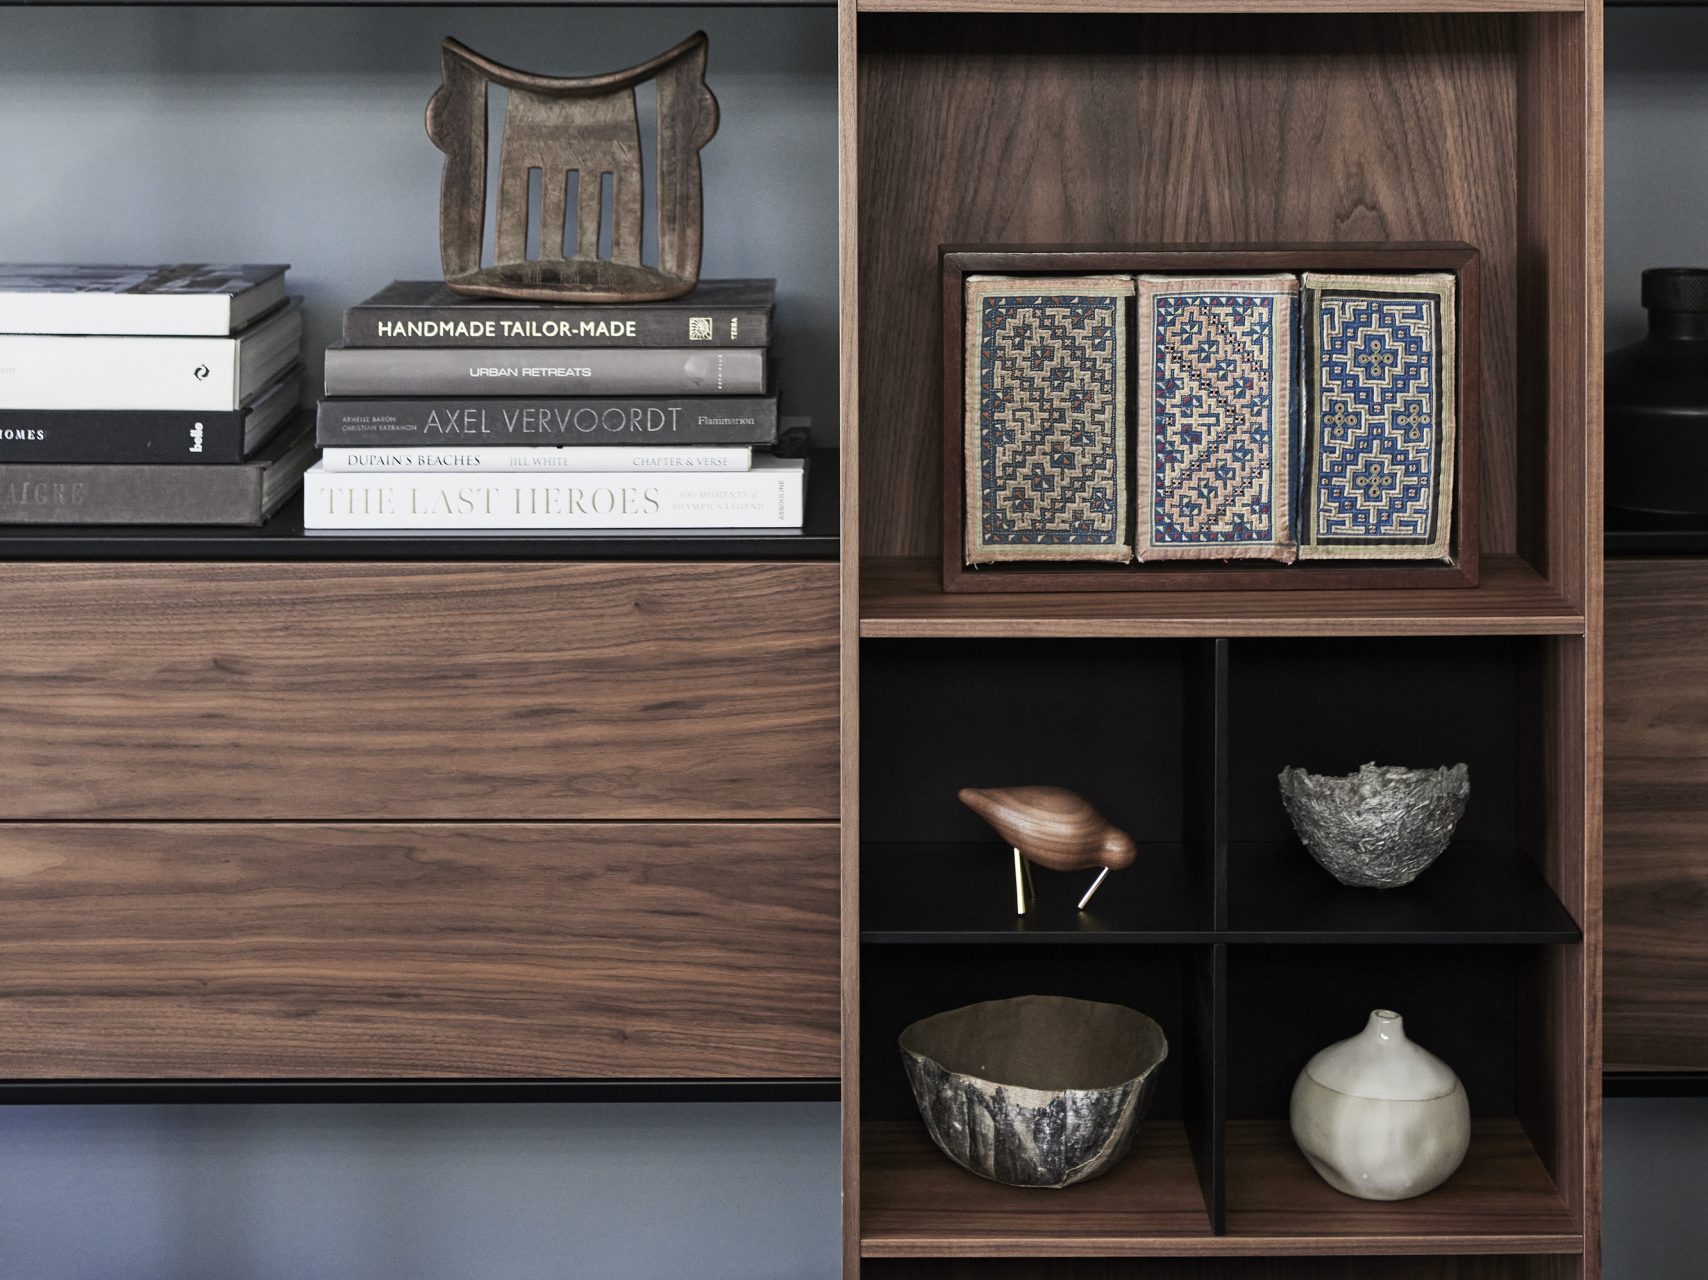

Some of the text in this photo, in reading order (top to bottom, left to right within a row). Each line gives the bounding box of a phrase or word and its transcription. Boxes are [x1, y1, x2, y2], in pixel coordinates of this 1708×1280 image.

[378, 321, 637, 337] HANDMADE TAILOR-MADE
[730, 317, 738, 340] TERRA
[469, 368, 592, 377] URBAN RETREATS
[423, 407, 682, 433] AXEL VERVOORDT
[698, 416, 755, 425] Flammarion
[348, 454, 481, 466] DUPAIN'S BEACHES
[533, 457, 569, 466] WHITE
[633, 457, 728, 467] CHAPTER & VERSE
[320, 487, 660, 515] THE LAST HEROES
